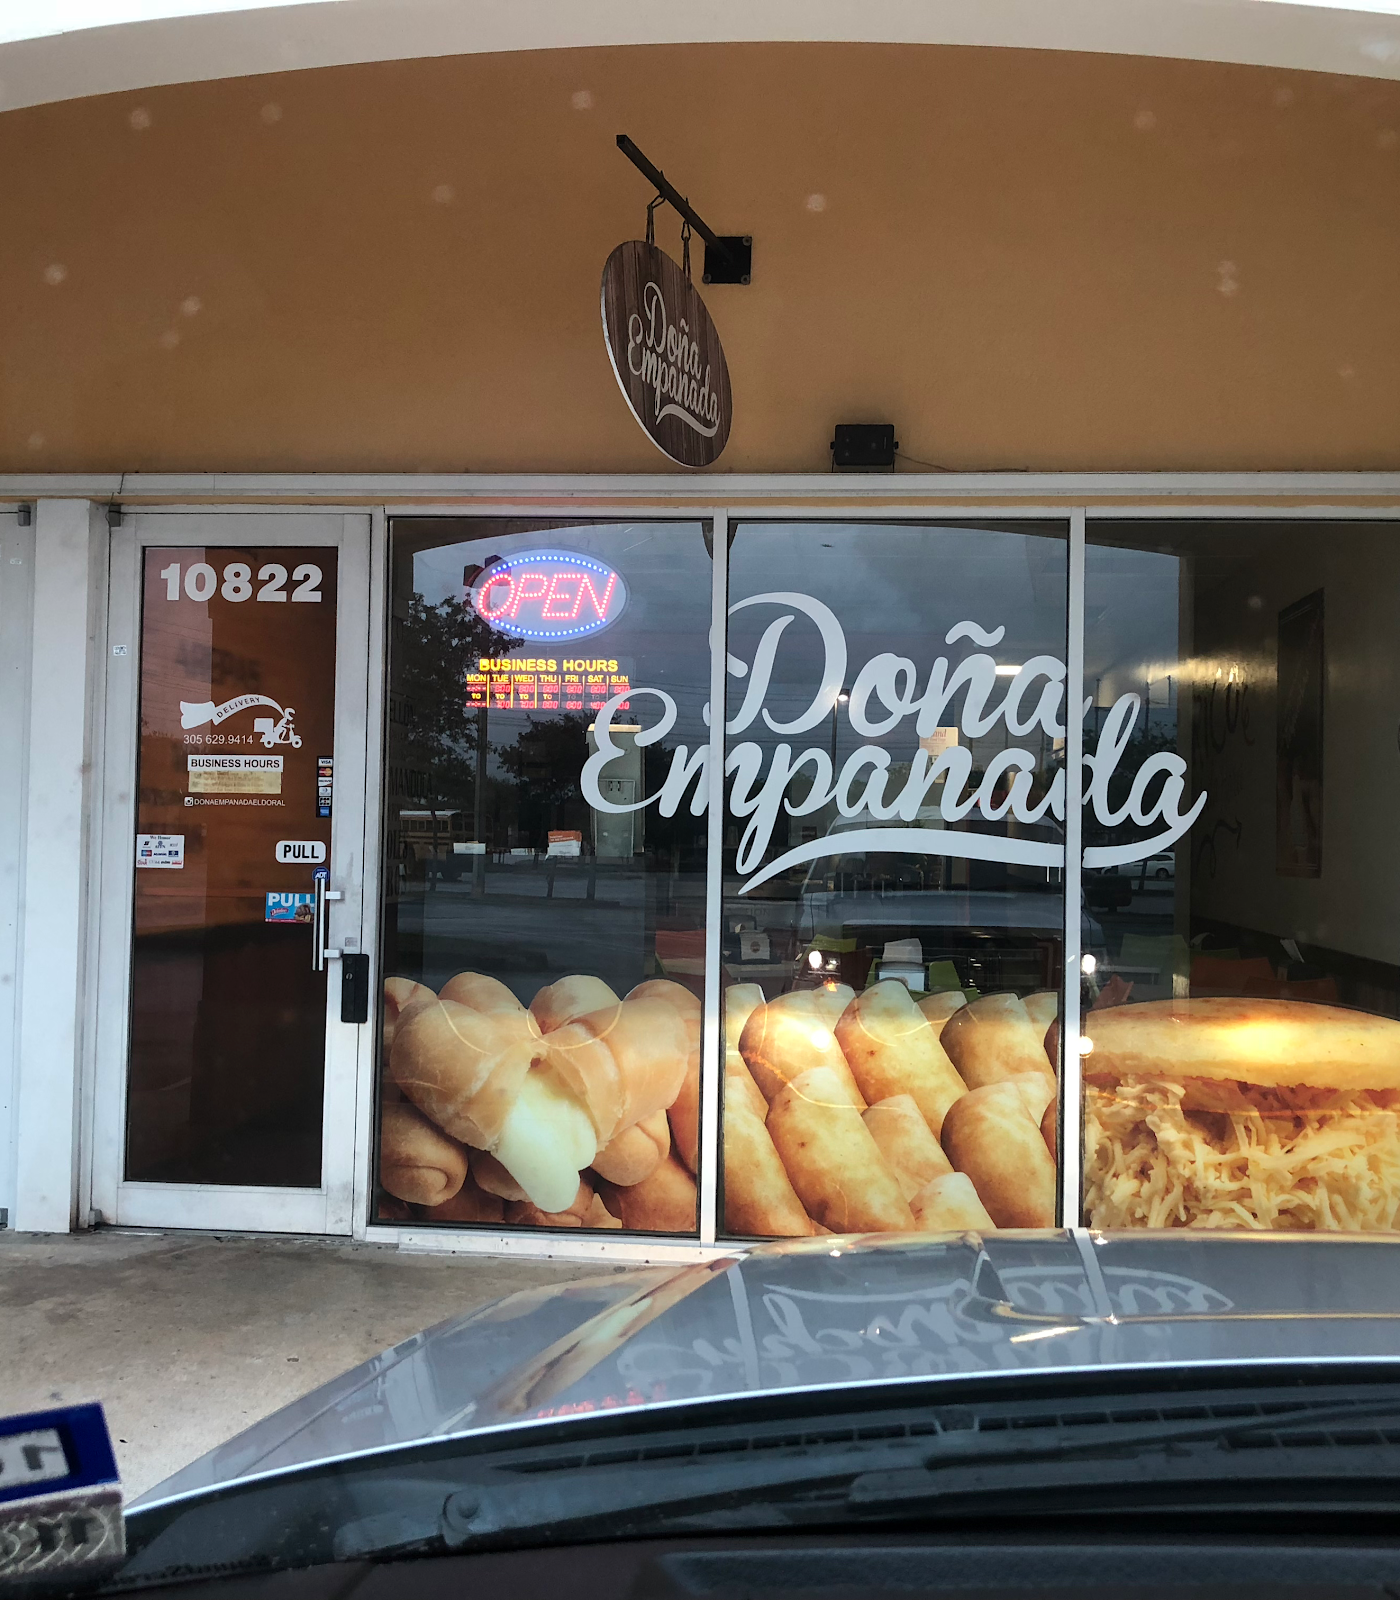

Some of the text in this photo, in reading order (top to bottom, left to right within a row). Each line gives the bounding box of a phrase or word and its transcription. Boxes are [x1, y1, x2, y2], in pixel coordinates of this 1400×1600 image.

[644, 282, 702, 380] Doña
[627, 313, 721, 437] Empanada
[160, 563, 323, 603] 10822
[478, 572, 617, 620] OPEN
[479, 658, 619, 673] BUSINESS HOURS
[703, 592, 1093, 738] Doña
[466, 674, 629, 683] MON TUE WED THU FRI SAT SUN
[471, 692, 482, 700] TO
[216, 696, 261, 718] DELIVERY
[183, 734, 254, 745] 305 629.9414
[190, 758, 280, 769] BUSINESS HOURS
[581, 687, 1207, 895] Empanada
[194, 798, 286, 807] DONAEMPANADAELDORAL
[283, 844, 320, 859] PULL
[314, 871, 328, 879] ADT
[268, 892, 315, 908] PULL
